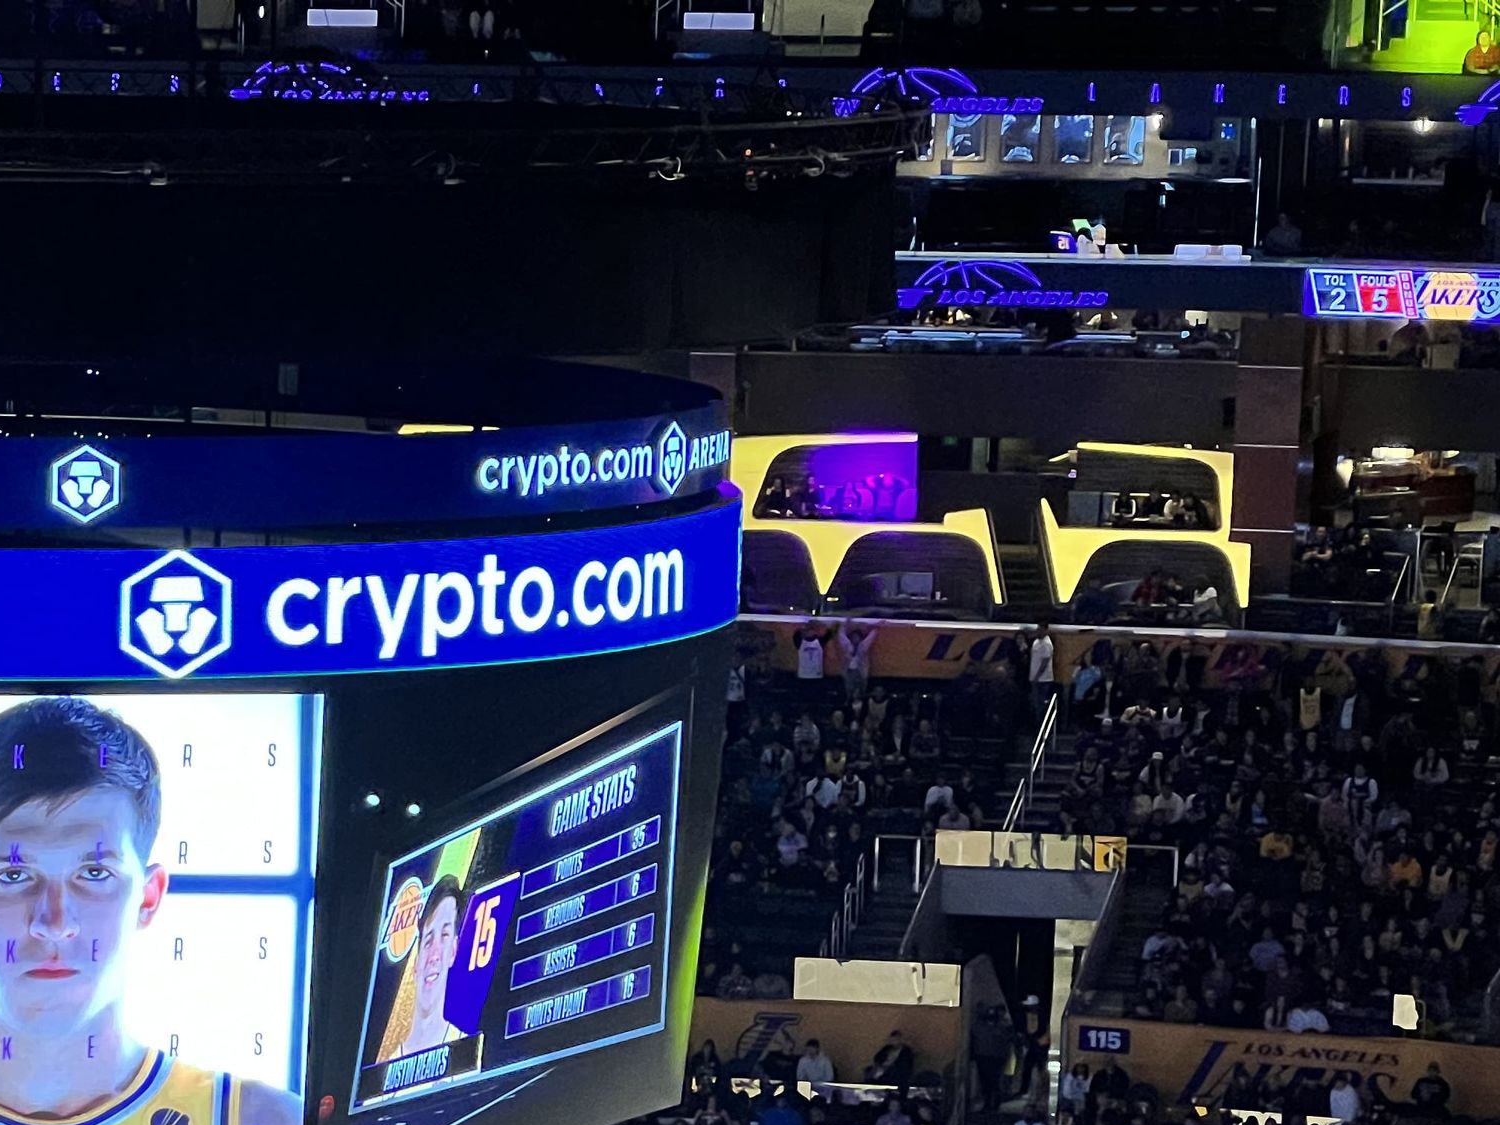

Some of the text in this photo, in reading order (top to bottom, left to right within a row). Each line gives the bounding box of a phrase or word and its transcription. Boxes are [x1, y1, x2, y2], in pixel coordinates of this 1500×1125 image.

[1323, 274, 1347, 287] TOL
[1360, 275, 1397, 288] FOULS
[986, 290, 1109, 307] ANGELES
[1329, 287, 1347, 311] 2
[1372, 288, 1389, 312] 5
[689, 429, 731, 471] ARENA
[478, 444, 654, 497] crypto.com
[266, 547, 685, 660] crypto.com
[550, 764, 638, 838] GAME STATS
[631, 824, 647, 849] 35
[631, 872, 640, 897] 6
[468, 895, 501, 972] 15
[543, 922, 637, 977] ASSISTS 6
[622, 972, 635, 1000] 16
[1086, 1029, 1122, 1050] 115
[1241, 1042, 1401, 1068] LOS ANGELES
[383, 1045, 450, 1092] AUSTIN REAVES
